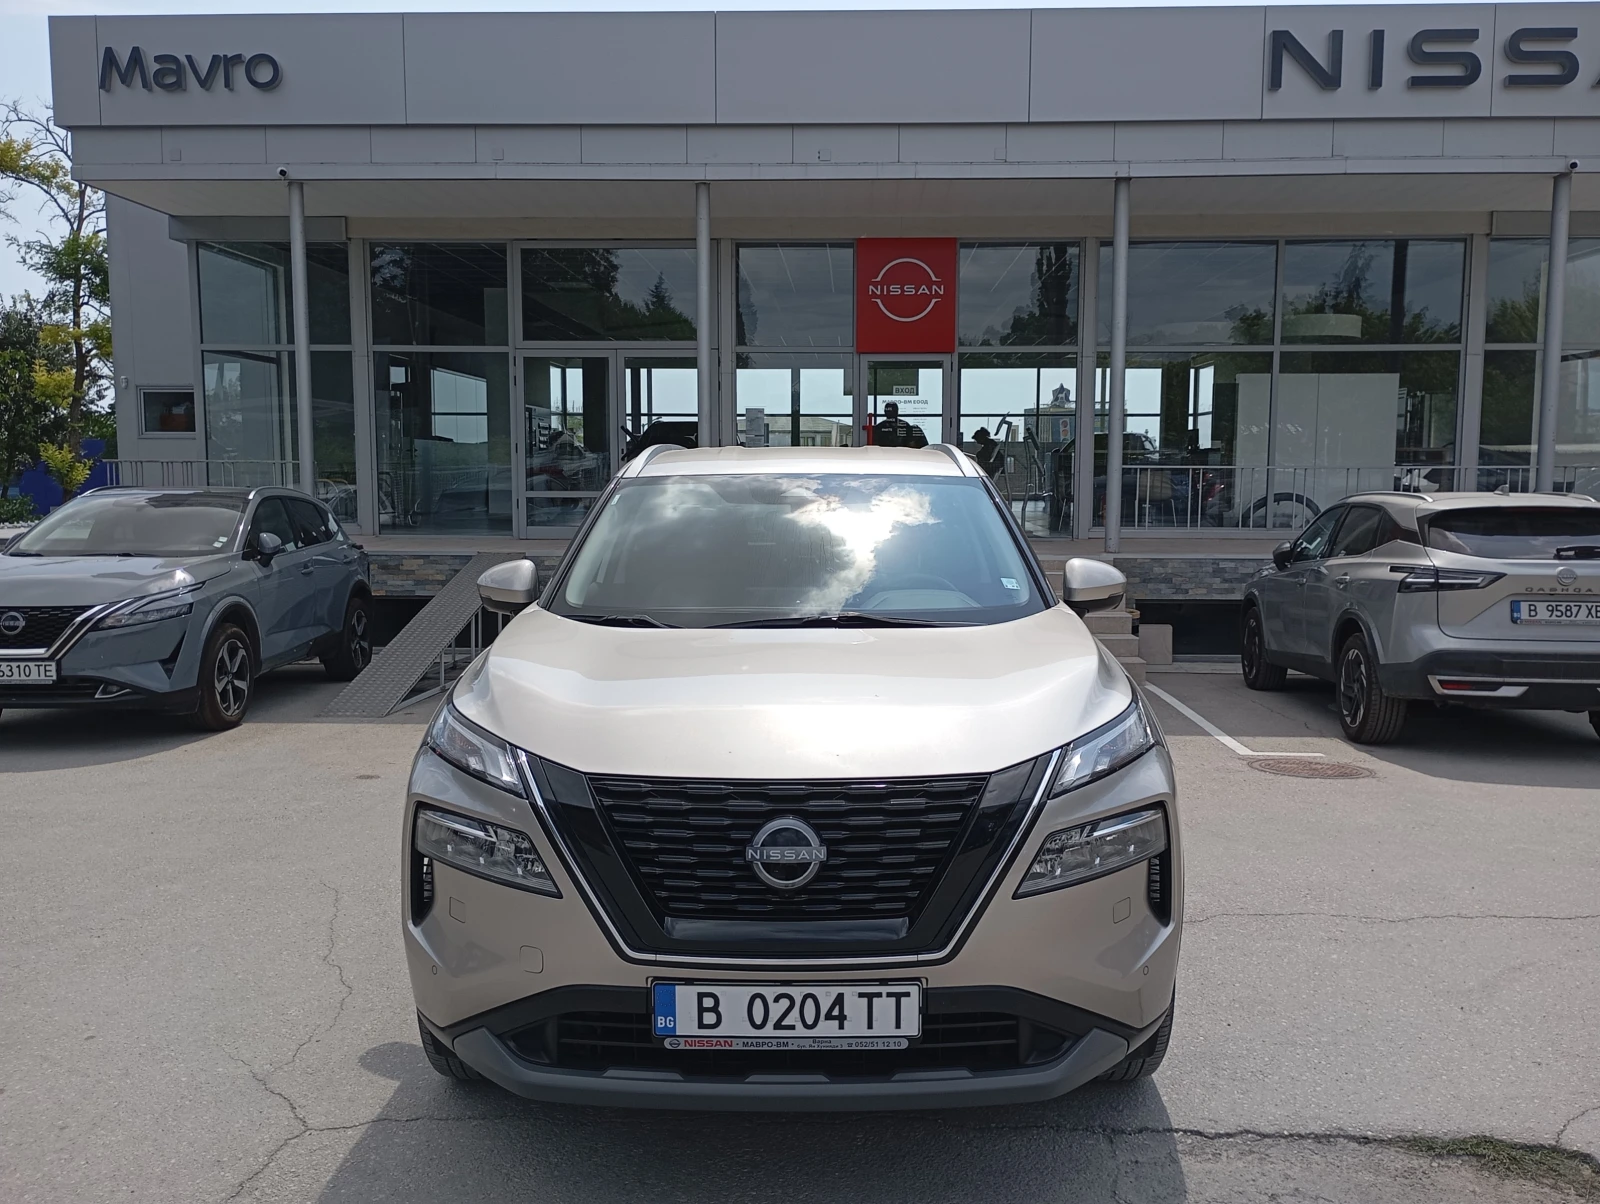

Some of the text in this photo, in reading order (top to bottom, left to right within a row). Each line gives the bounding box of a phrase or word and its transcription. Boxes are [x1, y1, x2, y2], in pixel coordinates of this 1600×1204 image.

[1269, 27, 1600, 91] NISS
[99, 46, 283, 92] Mavro
[868, 284, 945, 296] NISSAN
[1528, 604, 1538, 618] B
[1546, 604, 1582, 619] 9587
[34, 664, 54, 678] TE
[748, 849, 824, 860] NISSAN
[696, 991, 911, 1030] B 0204 TT
[657, 1016, 675, 1028] BG
[683, 1039, 733, 1048] NISSAN
